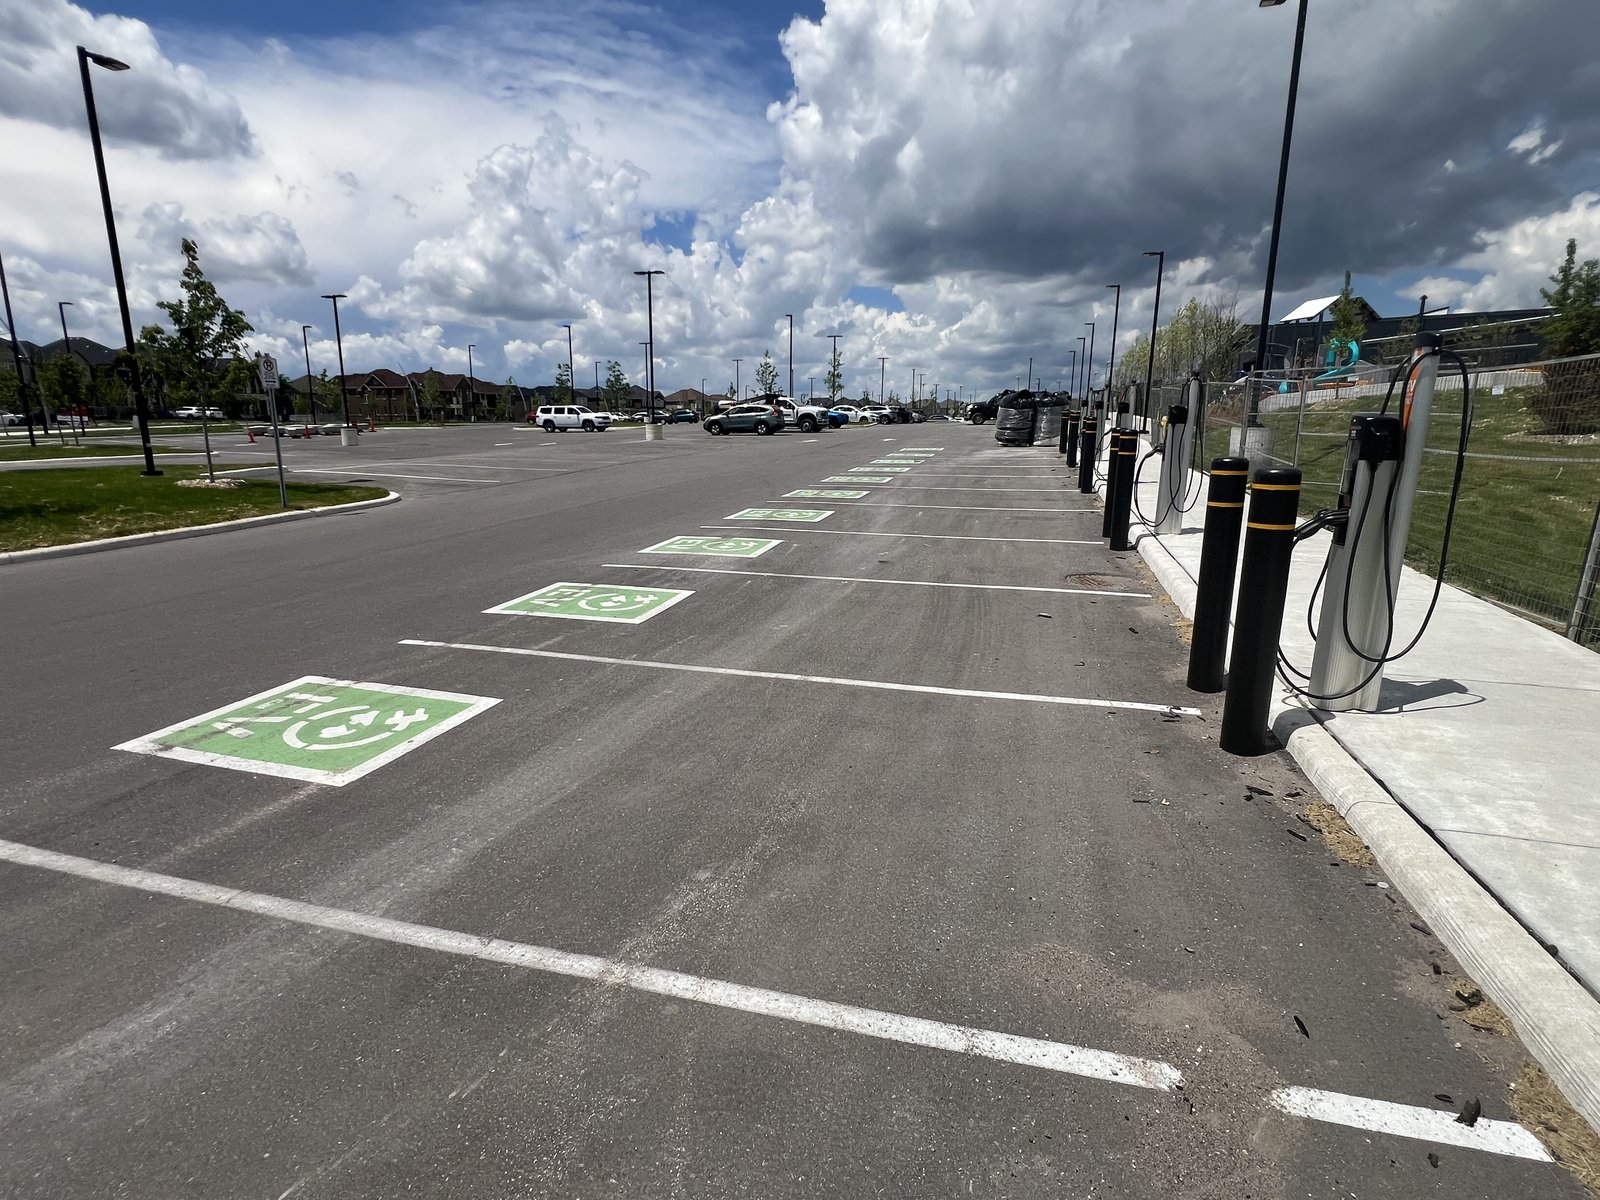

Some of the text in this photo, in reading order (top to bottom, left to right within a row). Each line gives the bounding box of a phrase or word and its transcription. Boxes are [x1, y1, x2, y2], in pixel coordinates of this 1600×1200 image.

[666, 539, 706, 550] EV
[529, 588, 592, 607] EV
[211, 692, 338, 739] EV
